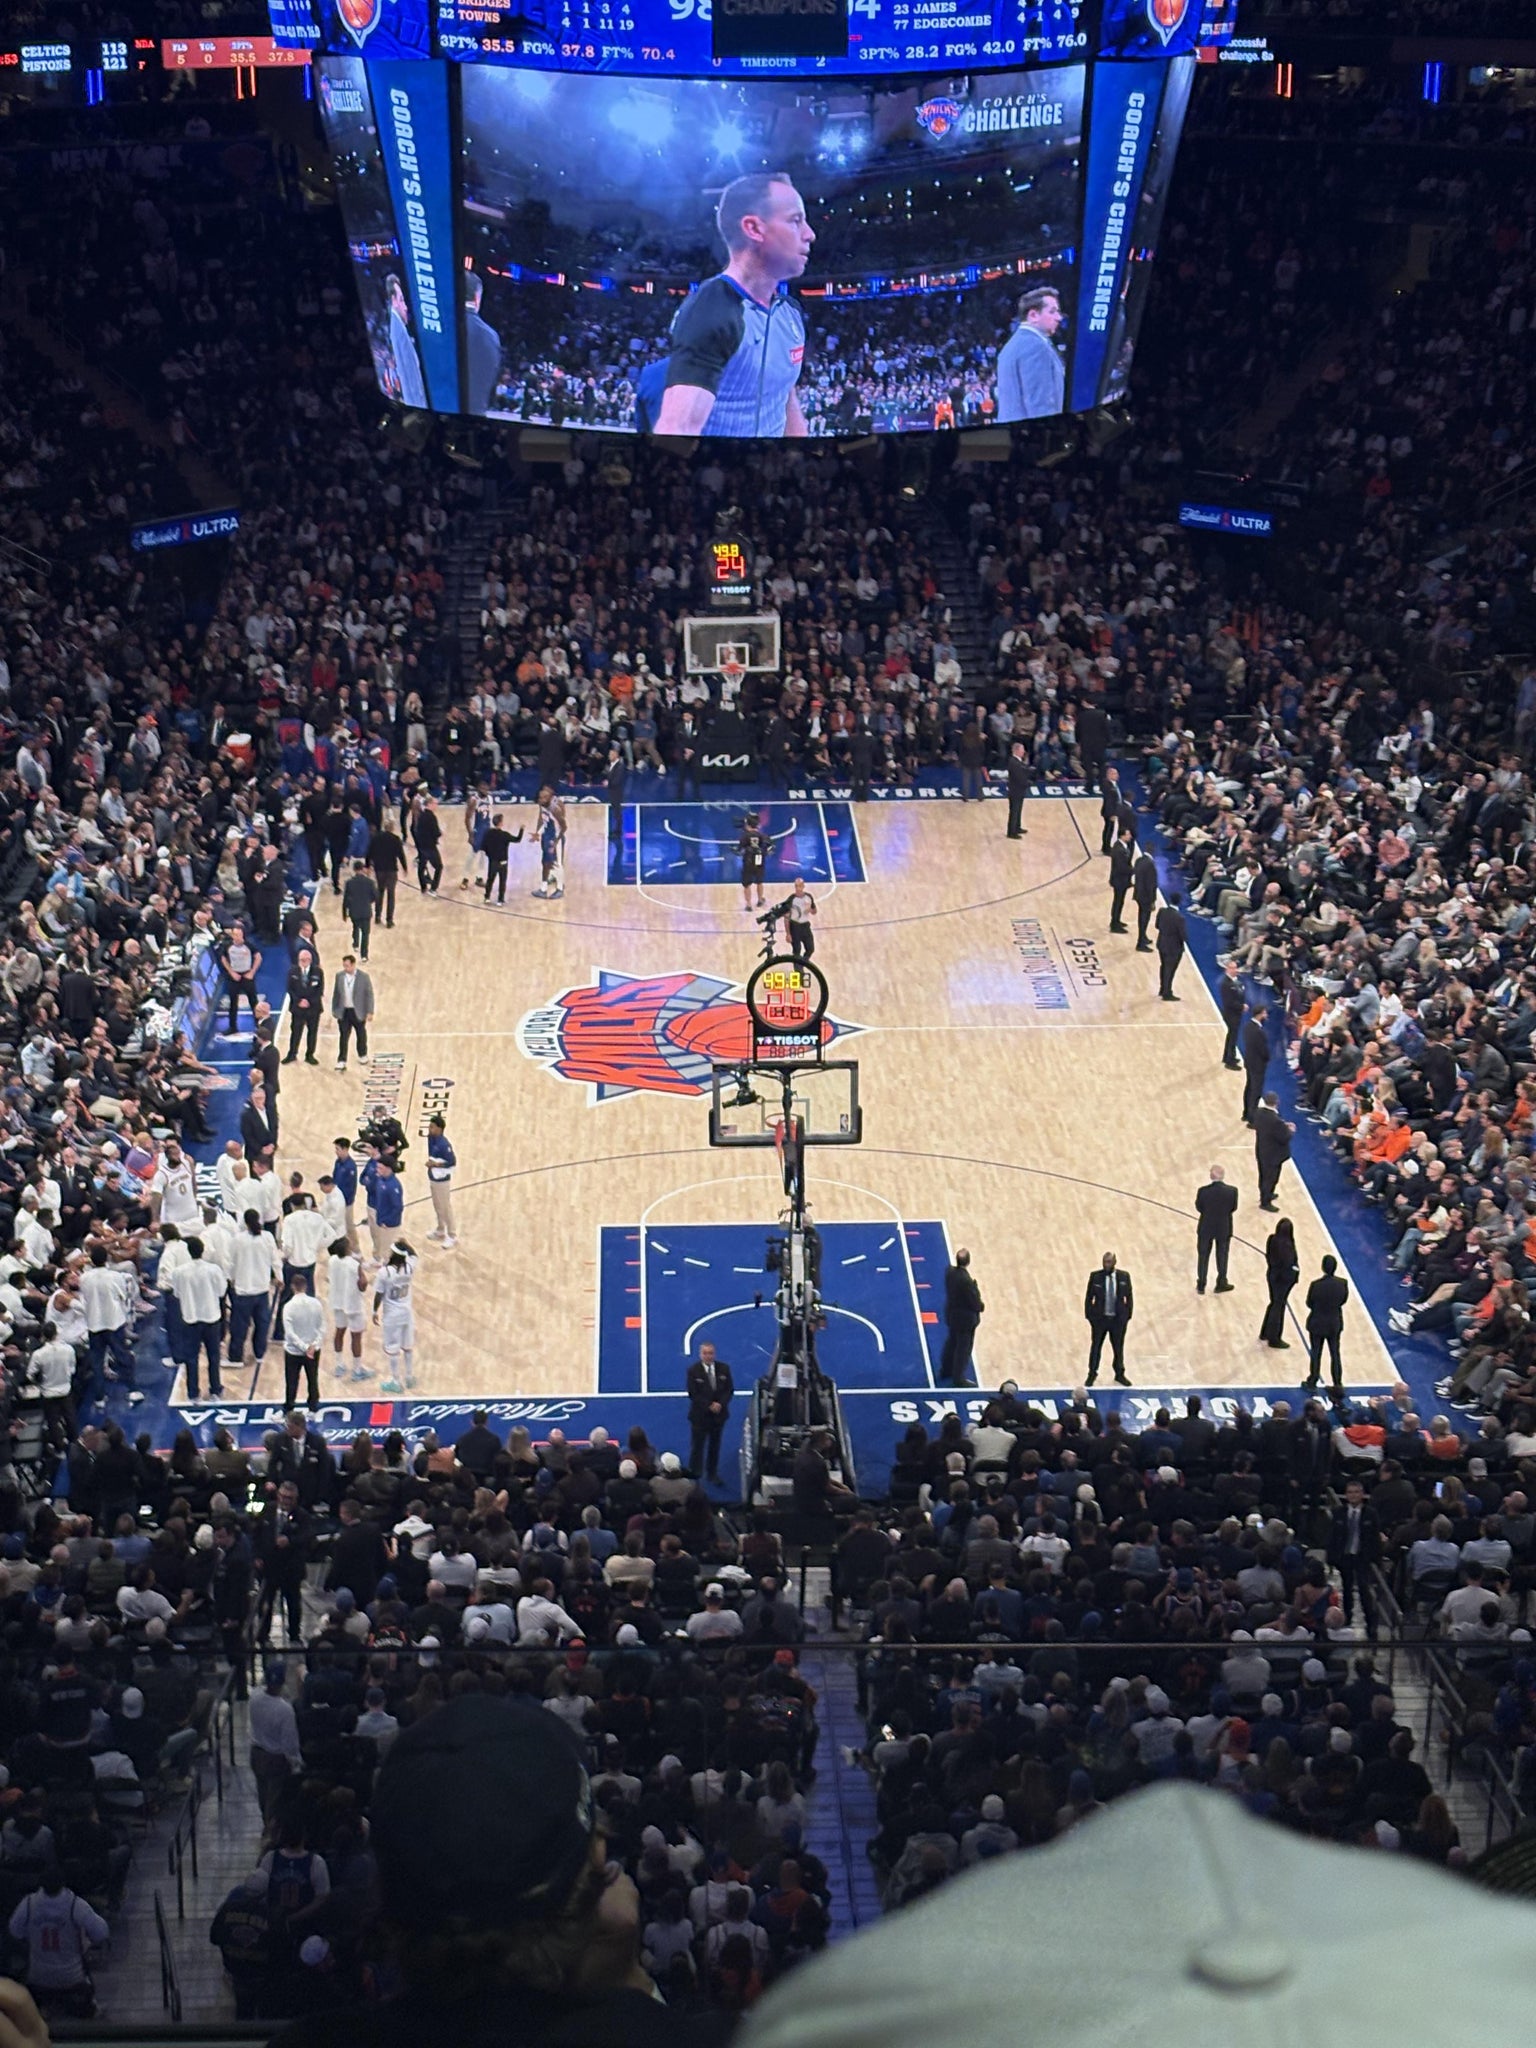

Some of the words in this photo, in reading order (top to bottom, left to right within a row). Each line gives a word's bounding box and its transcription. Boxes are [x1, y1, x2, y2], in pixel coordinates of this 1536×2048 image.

[439, 8, 455, 19] 32
[458, 9, 500, 23] TOWNS
[602, 3, 610, 14] 3
[622, 4, 630, 15] 4
[669, 0, 712, 20] 9
[893, 4, 909, 15] 23
[913, 2, 957, 14] JAMES
[1071, 7, 1079, 19] 9
[561, 17, 571, 28] 4
[583, 18, 590, 29] 1
[600, 19, 614, 30] 11
[619, 20, 634, 31] 19
[893, 20, 909, 30] 77
[913, 15, 992, 30] EDGECOMBE
[21, 44, 71, 58] CELTICS
[102, 42, 127, 55] 113
[440, 34, 479, 50] 3PT%
[481, 38, 515, 53] 35.5
[522, 41, 555, 55] FG%
[561, 44, 595, 58] 37.8
[602, 46, 634, 59] FT%
[641, 47, 676, 60] 70.4
[859, 47, 900, 60] 3PT%
[905, 45, 939, 59] 28.2
[945, 43, 977, 57] FG%
[982, 40, 1015, 54] 42.0
[1023, 37, 1052, 51] FT%
[1057, 32, 1087, 48] 76.0
[102, 57, 127, 70] 121
[177, 54, 185, 64] 5
[204, 54, 212, 64] 0
[230, 53, 256, 63] 35.5
[268, 52, 295, 62] 37.8
[741, 57, 796, 67] TIMEOUTS
[22, 58, 71, 72] PISTONS
[982, 93, 1047, 109] COACH'S
[964, 103, 1063, 133] CHALLENGE
[390, 87, 422, 202] COACH'S
[1112, 91, 1145, 198] COACH'S
[405, 198, 442, 333] CHALLENGE
[1088, 201, 1127, 332] CHALLENGE
[192, 516, 240, 537] ULTRA
[1231, 515, 1271, 531] ULTRA
[716, 555, 745, 579] 24
[788, 789, 852, 799] NEW
[871, 788, 964, 797] YORK
[1072, 949, 1108, 986] CHASE
[764, 971, 801, 989] 49.8
[523, 1009, 563, 1035] YORK
[557, 973, 704, 1096] KNICKS
[774, 1035, 818, 1045] TISSOT
[523, 1036, 561, 1058] NEW
